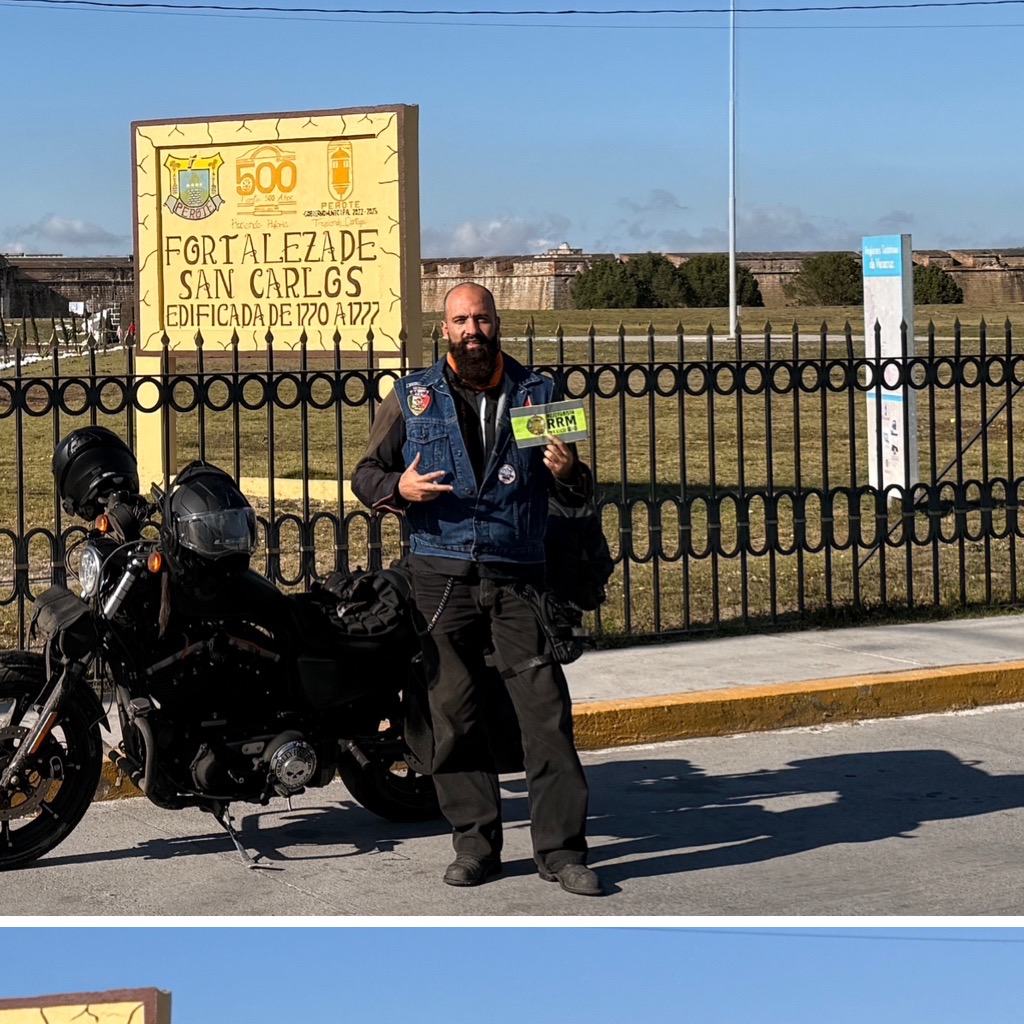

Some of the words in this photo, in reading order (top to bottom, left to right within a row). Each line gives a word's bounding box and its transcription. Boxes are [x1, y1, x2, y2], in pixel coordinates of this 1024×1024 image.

[175, 200, 215, 218] PEROTE
[321, 200, 360, 210] PEROTE
[179, 268, 233, 299] SAN
[250, 266, 363, 298] CARLOS
[296, 302, 329, 326] 1770
[347, 302, 380, 326] 1777
[547, 415, 577, 429] RRM
